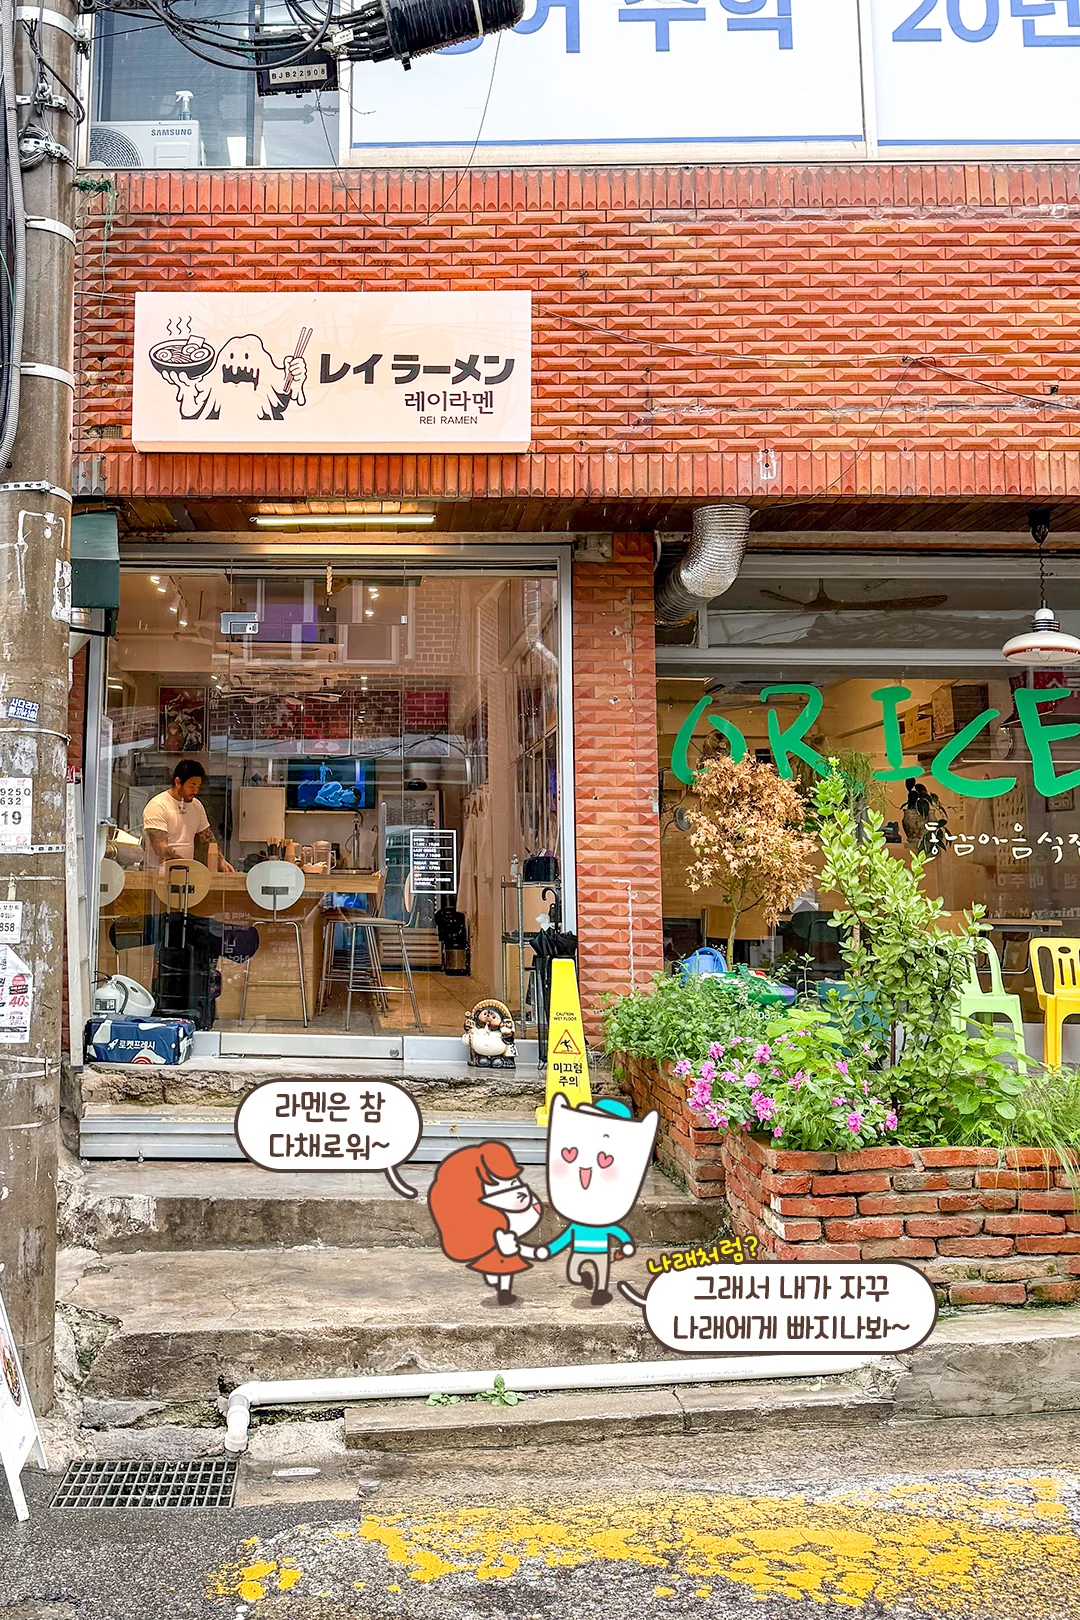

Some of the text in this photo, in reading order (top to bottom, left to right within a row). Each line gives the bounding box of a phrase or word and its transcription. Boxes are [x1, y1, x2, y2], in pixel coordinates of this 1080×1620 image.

[271, 68, 326, 80] BJB22908
[151, 128, 192, 136] SAMSUNG
[404, 390, 494, 415] 레이라멘
[419, 416, 478, 425] REI RAMEN
[118, 1040, 156, 1051] 로켓프레시
[553, 1062, 582, 1073] 미끄럼
[558, 1075, 579, 1087] 주의
